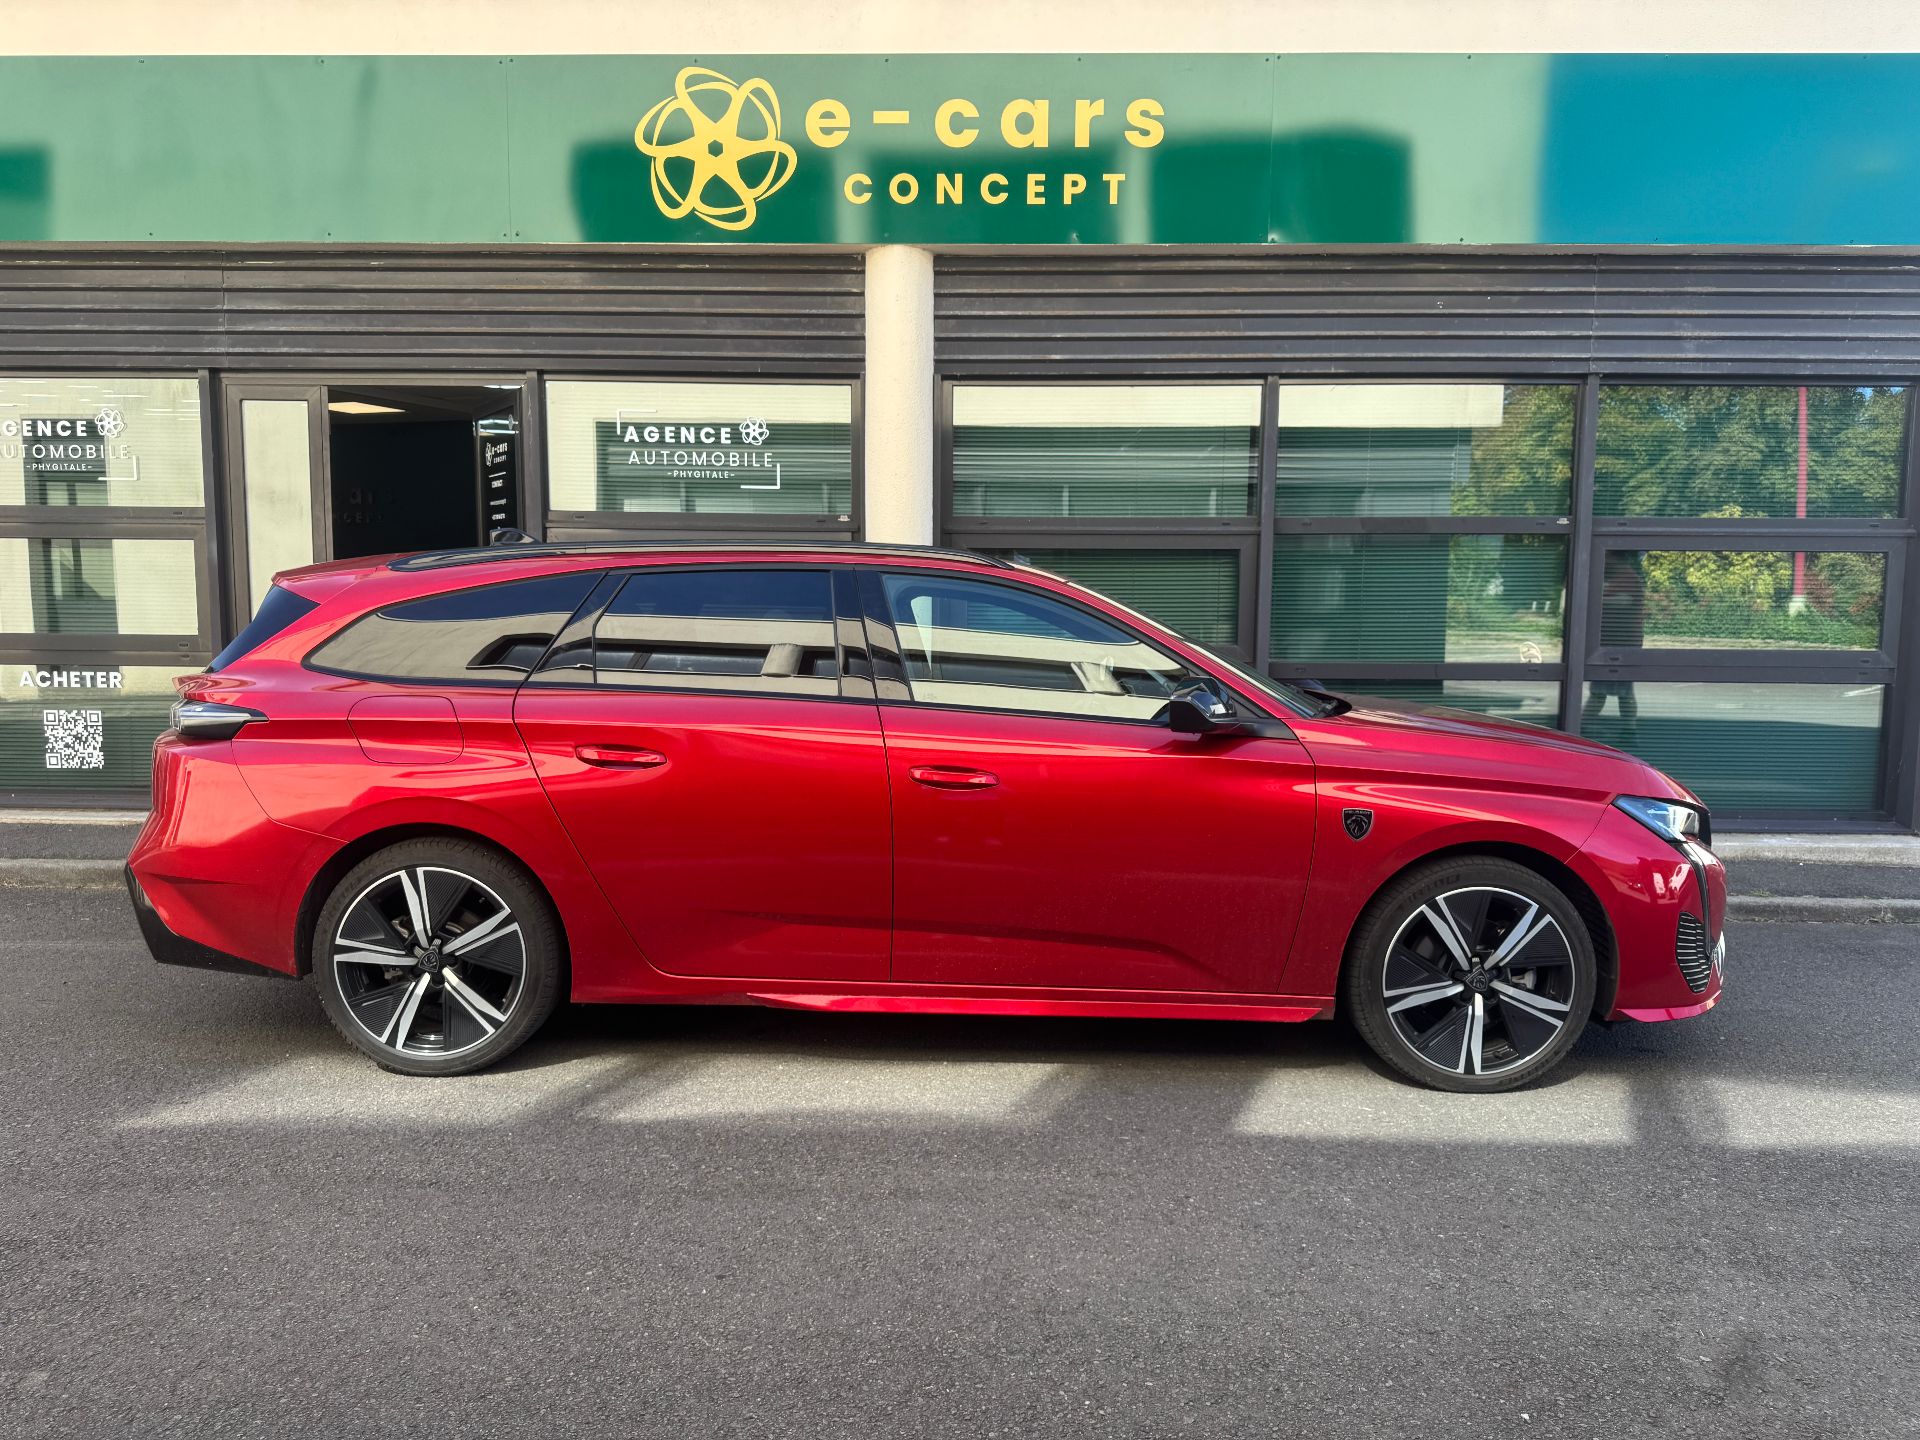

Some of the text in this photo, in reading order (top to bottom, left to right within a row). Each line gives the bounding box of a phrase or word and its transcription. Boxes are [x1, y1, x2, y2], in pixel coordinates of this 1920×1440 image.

[805, 98, 1165, 149] e-cars
[843, 173, 1127, 205] CONCEPT
[0, 420, 88, 437] GENCE
[624, 426, 732, 444] AGENCE
[0, 444, 130, 459] UTOMOBILE
[628, 450, 773, 467] AUTOMOBILE
[20, 671, 123, 689] ACHETER
